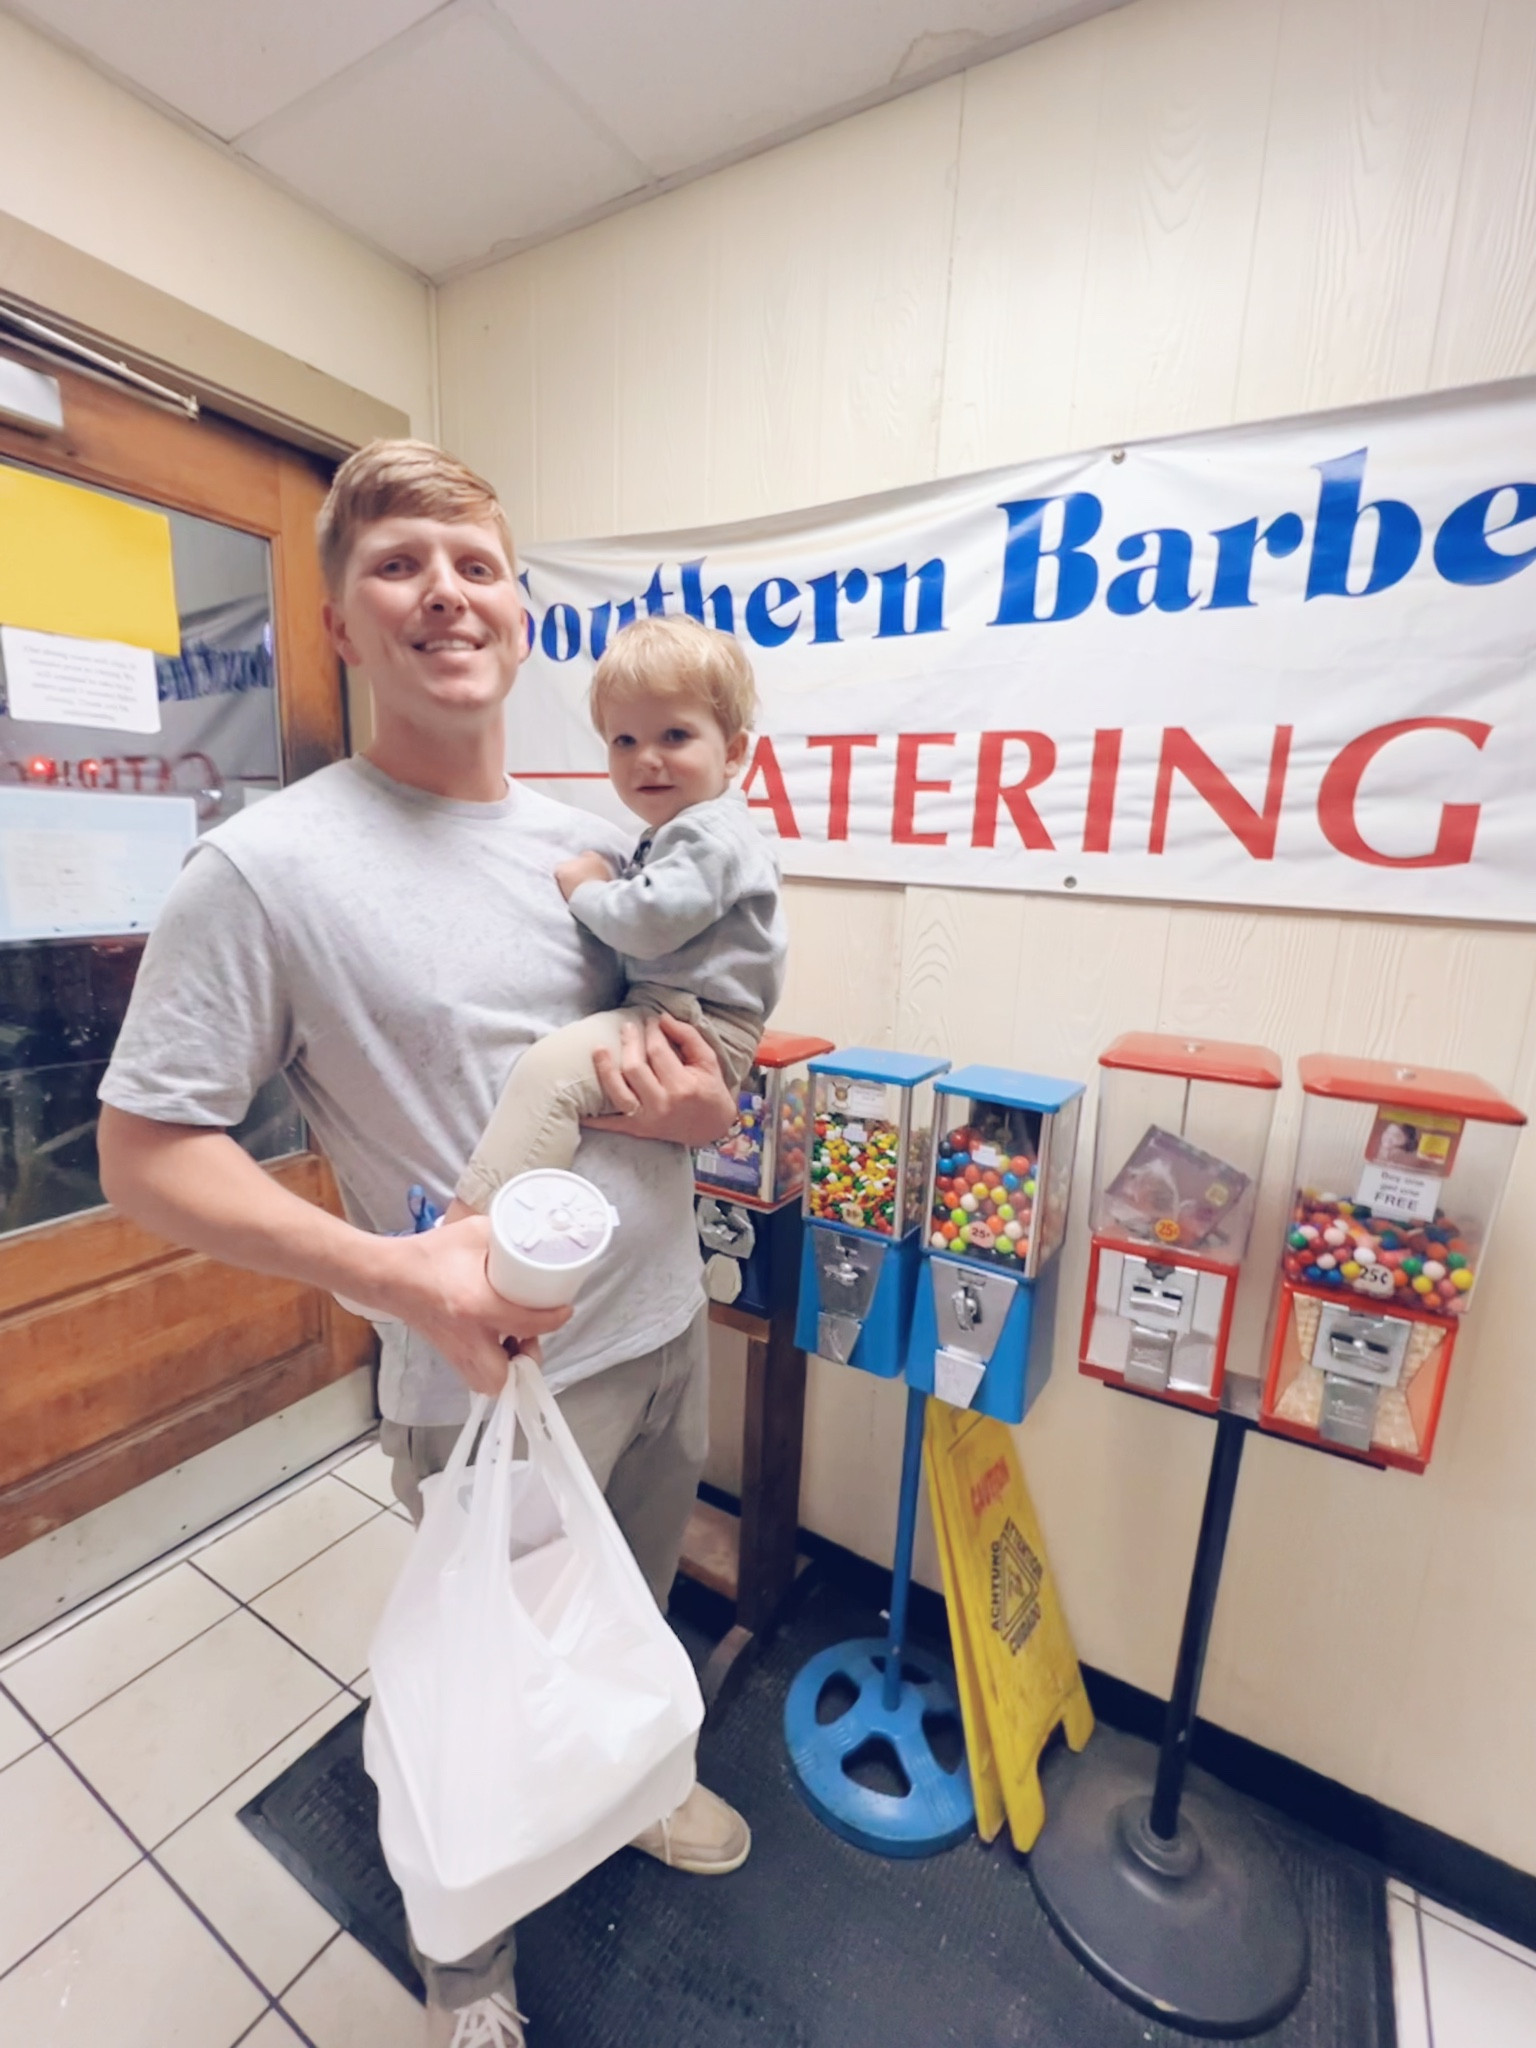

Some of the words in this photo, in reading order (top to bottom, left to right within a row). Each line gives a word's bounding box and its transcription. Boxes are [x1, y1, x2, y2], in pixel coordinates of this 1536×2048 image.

[986, 446, 1536, 626] Barbe
[742, 716, 1494, 869] ATERING
[1374, 1191, 1418, 1212] FREE
[991, 1540, 1001, 1632] ACHTUNG
